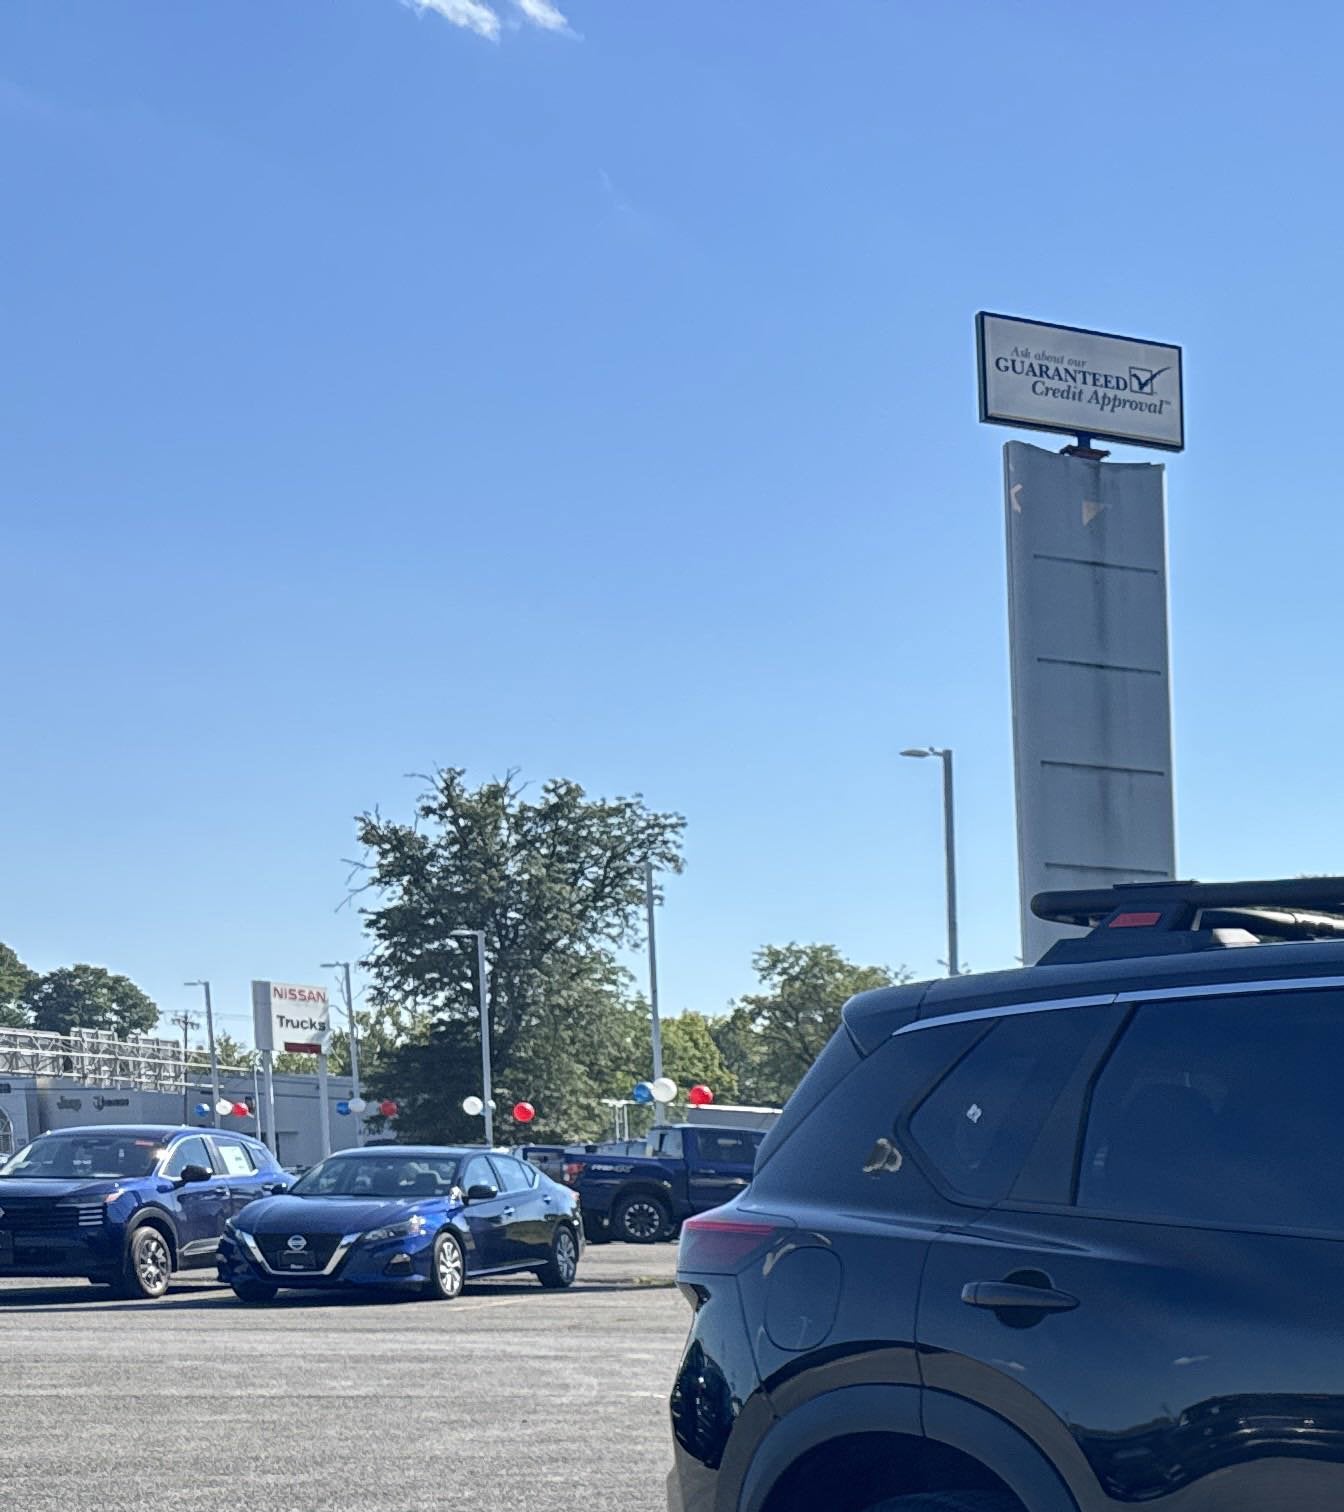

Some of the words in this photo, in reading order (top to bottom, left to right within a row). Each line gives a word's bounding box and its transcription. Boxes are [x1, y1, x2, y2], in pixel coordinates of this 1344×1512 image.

[1010, 346, 1031, 359] Ask
[1034, 350, 1065, 365] about
[1067, 357, 1088, 369] our
[995, 356, 1128, 391] GUARANTEED
[1031, 379, 1084, 402] Credit
[1087, 389, 1165, 415] Approval
[273, 986, 326, 1003] NISSAN
[276, 1014, 326, 1031] Trucks
